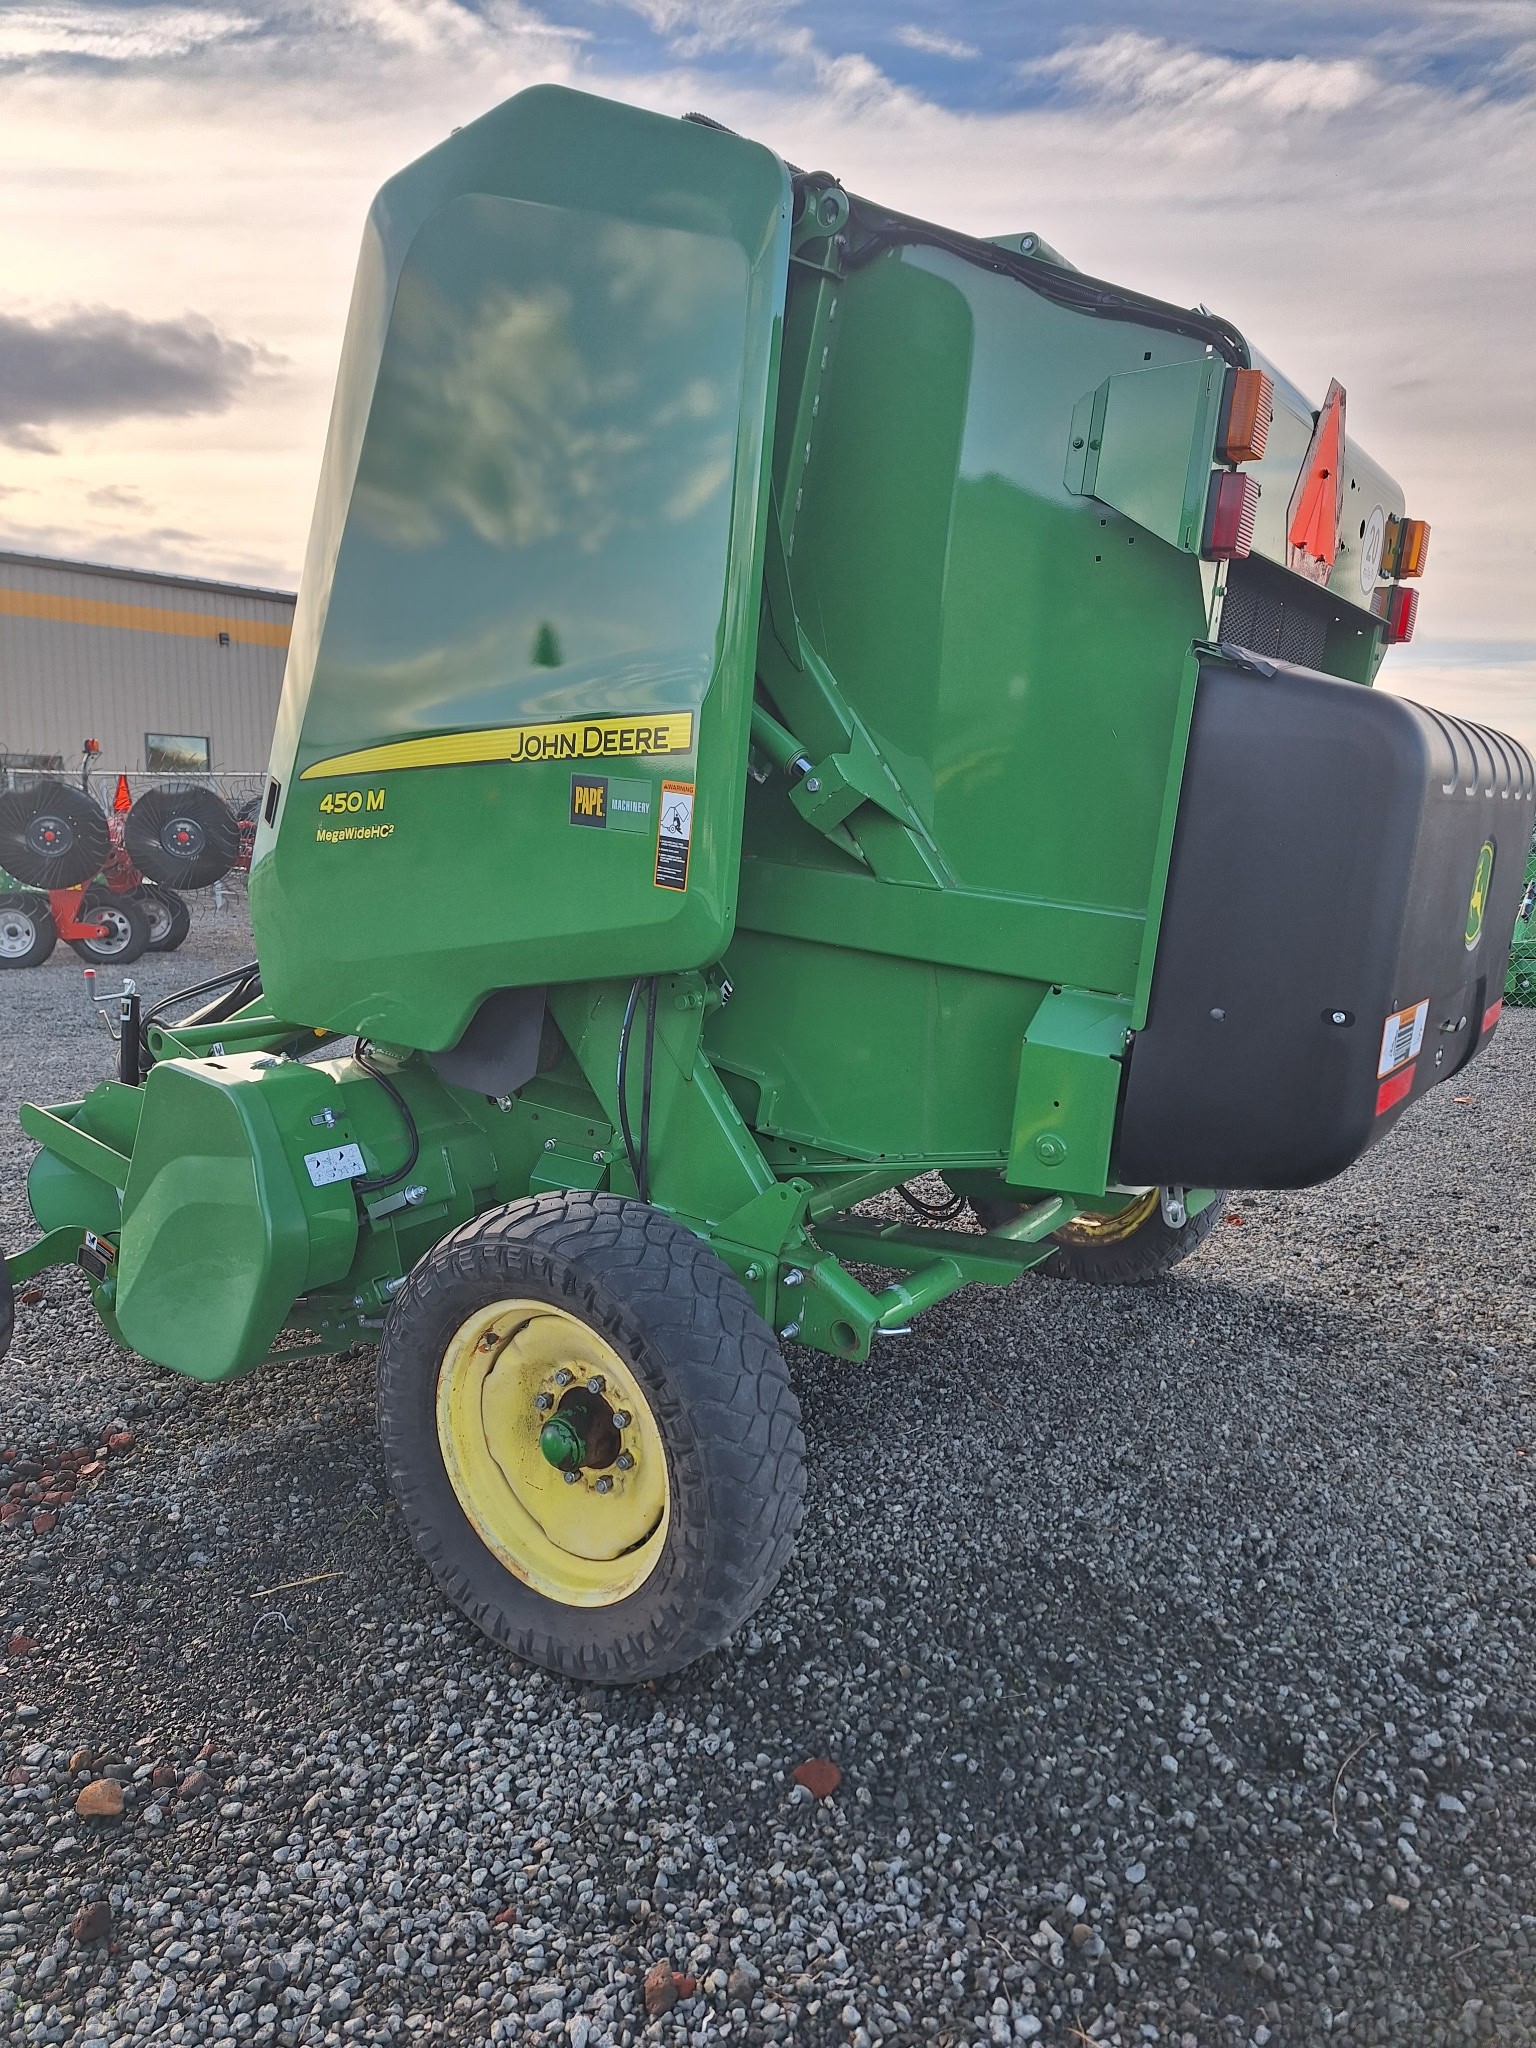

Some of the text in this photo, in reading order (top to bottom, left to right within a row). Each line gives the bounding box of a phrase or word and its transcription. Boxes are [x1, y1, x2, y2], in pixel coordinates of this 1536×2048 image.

[1366, 524, 1379, 564] 20
[510, 726, 669, 758] JOHN DEERE
[319, 788, 386, 814] 450 M
[667, 783, 694, 793] WARNING
[611, 799, 650, 814] MACHINERY
